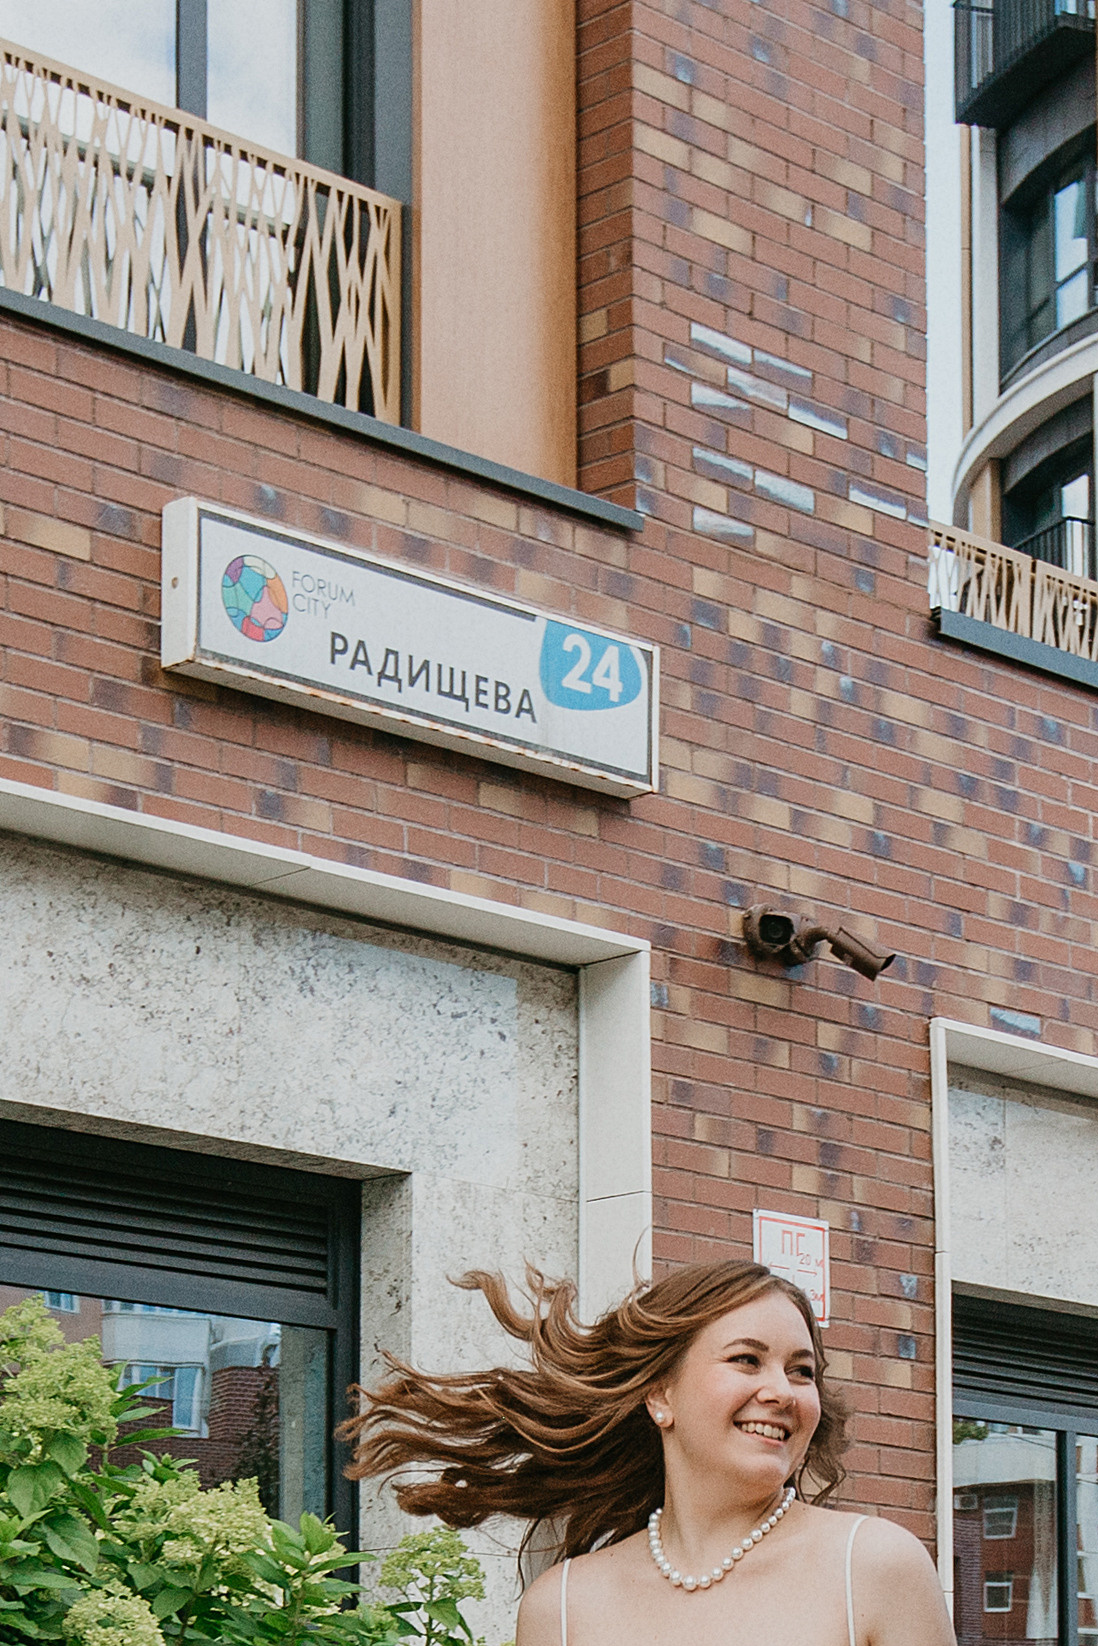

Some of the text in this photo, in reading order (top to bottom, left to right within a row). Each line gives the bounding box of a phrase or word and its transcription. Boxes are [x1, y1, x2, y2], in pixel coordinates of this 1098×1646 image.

[292, 570, 356, 607] FORUM
[292, 593, 332, 620] CITY
[330, 631, 537, 723] РАДИЩЕВА
[561, 633, 623, 702] 24
